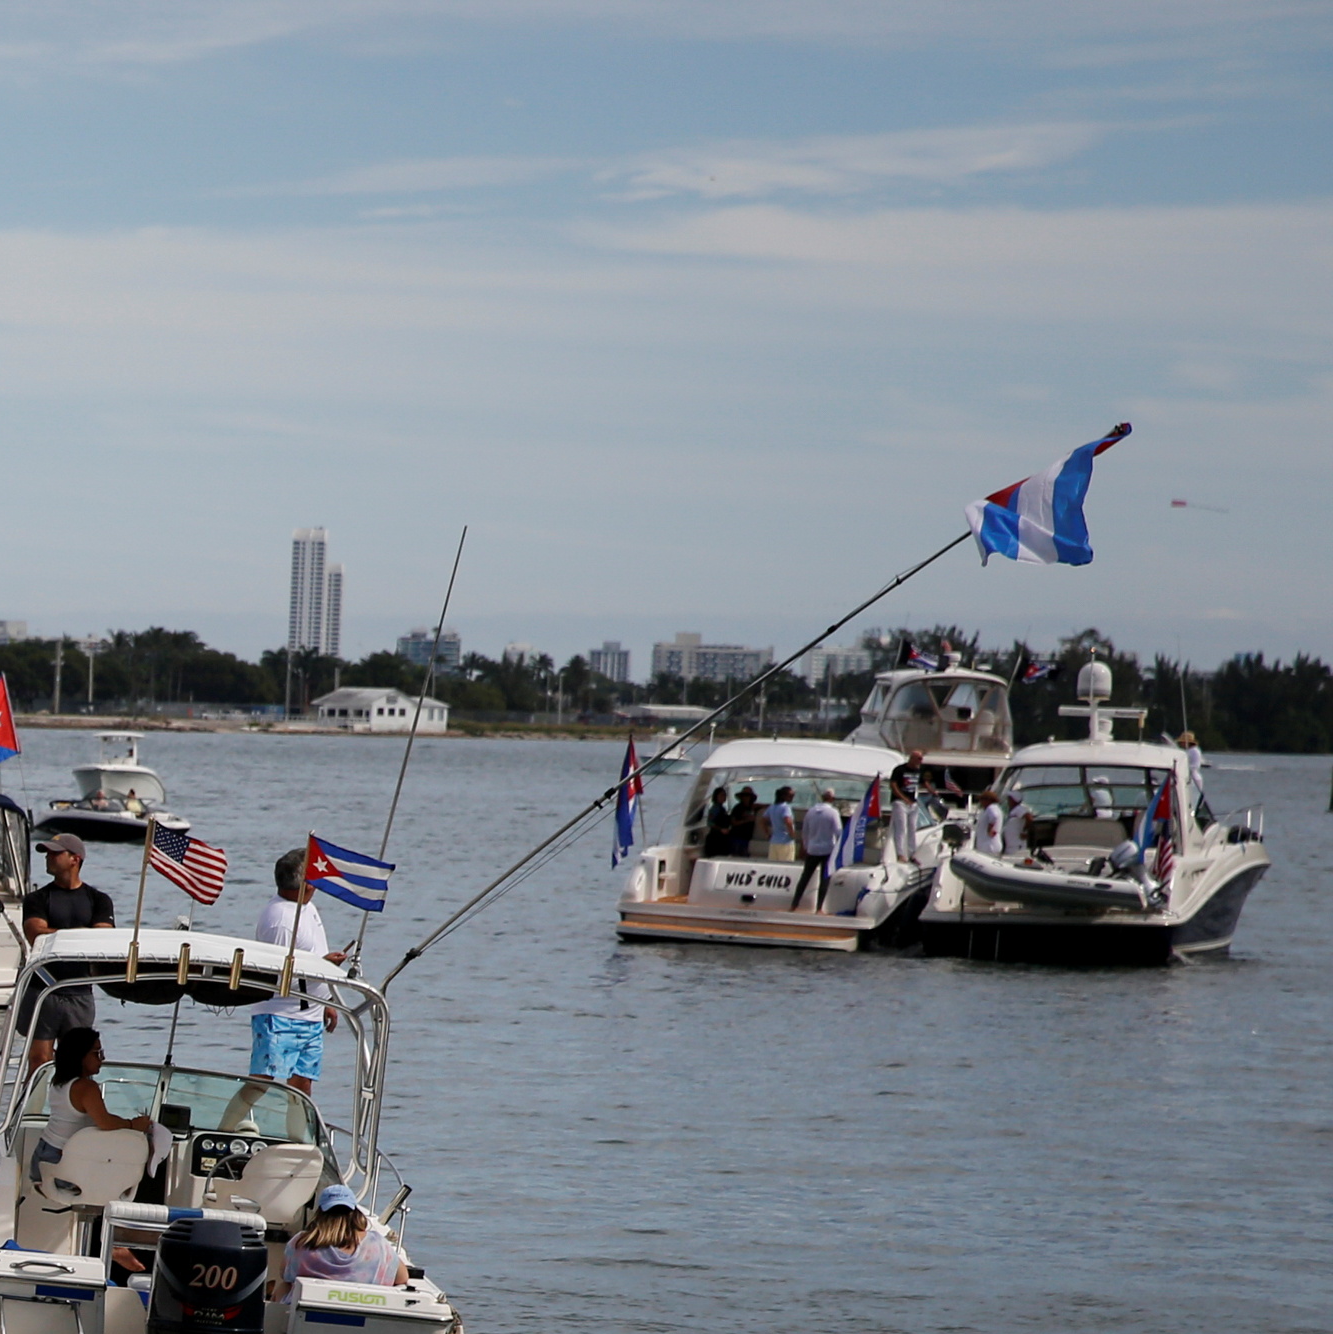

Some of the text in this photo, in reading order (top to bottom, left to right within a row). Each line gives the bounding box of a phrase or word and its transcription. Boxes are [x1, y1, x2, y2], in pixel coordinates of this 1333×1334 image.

[726, 870, 792, 889] WILD CHILD
[189, 1263, 238, 1290] 200
[328, 1290, 387, 1306] FUSION
